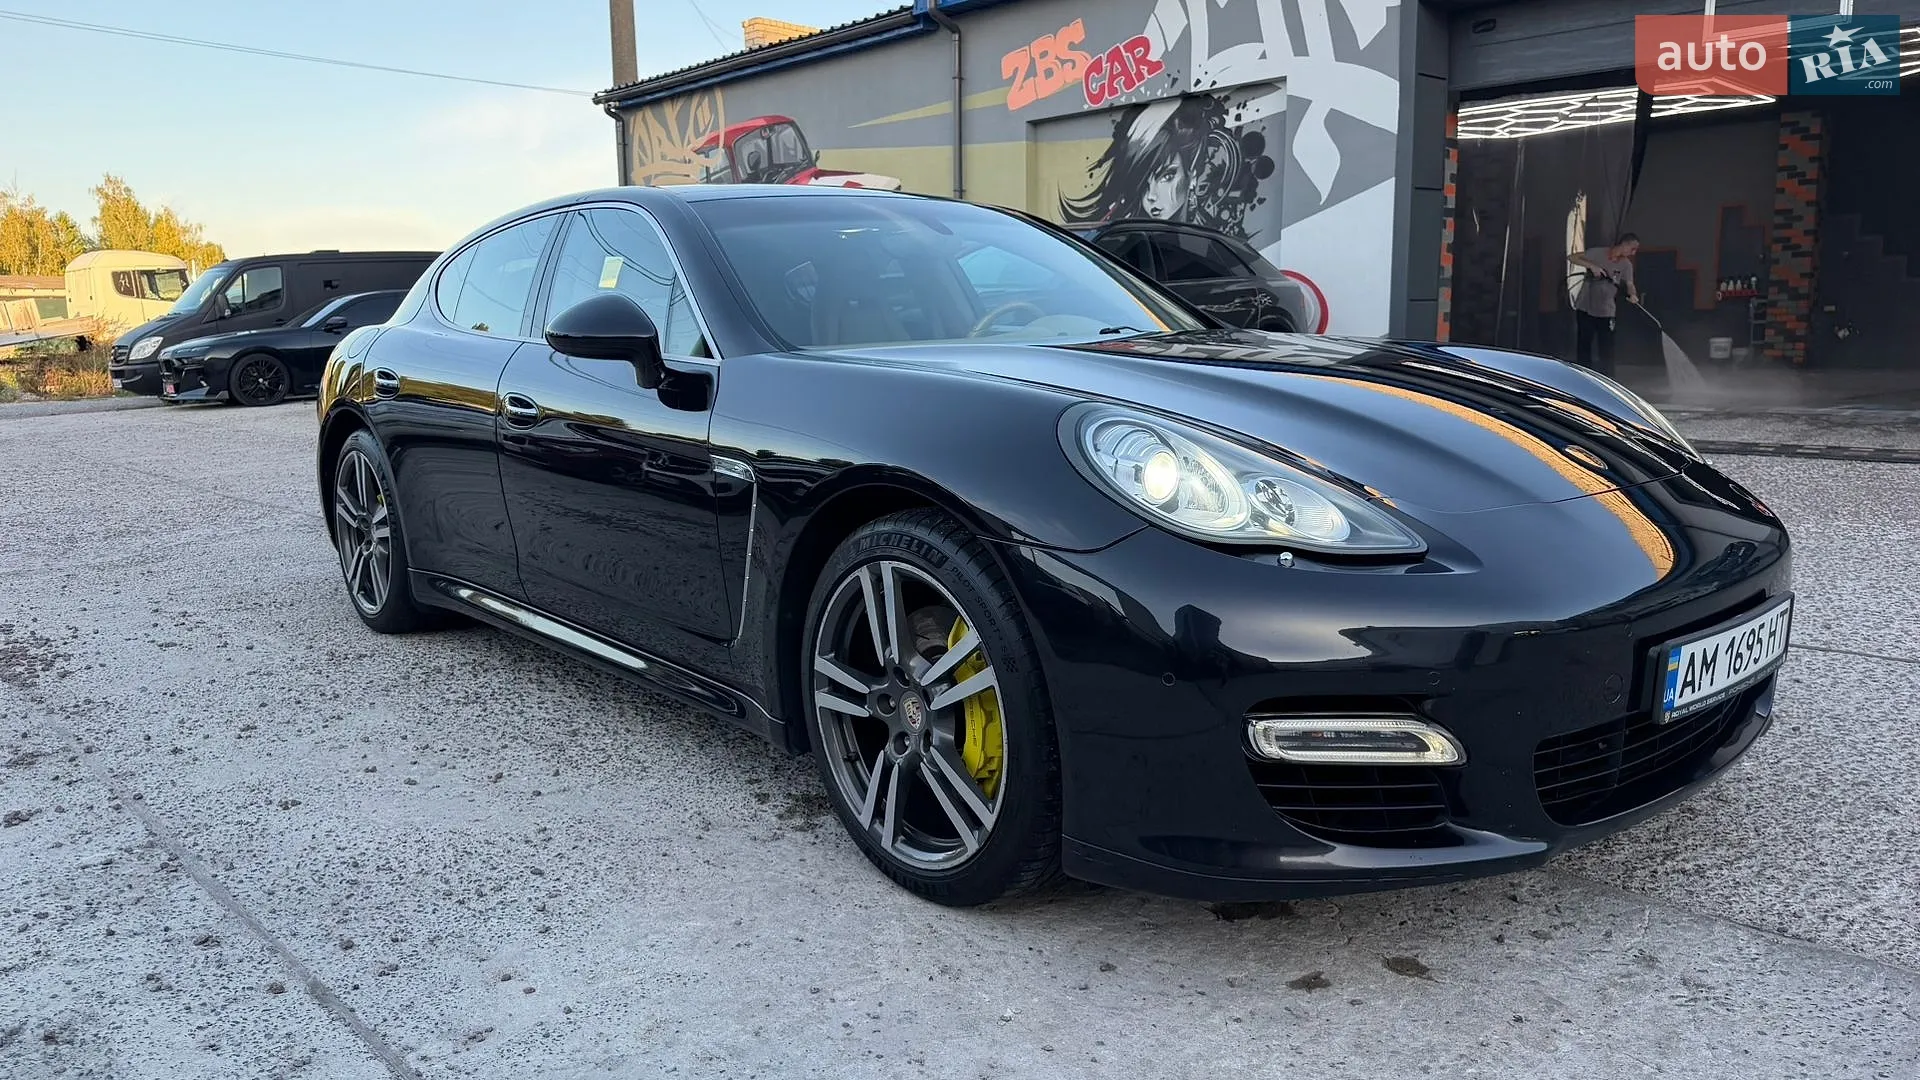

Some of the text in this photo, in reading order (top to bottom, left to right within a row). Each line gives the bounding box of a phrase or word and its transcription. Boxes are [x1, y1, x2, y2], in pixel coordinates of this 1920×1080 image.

[1000, 18, 1091, 112] ZBS
[1082, 34, 1165, 107] CAR
[859, 533, 949, 568] MICHELIN
[1678, 607, 1789, 699] AM 1695 HT
[1663, 688, 1675, 703] UA
